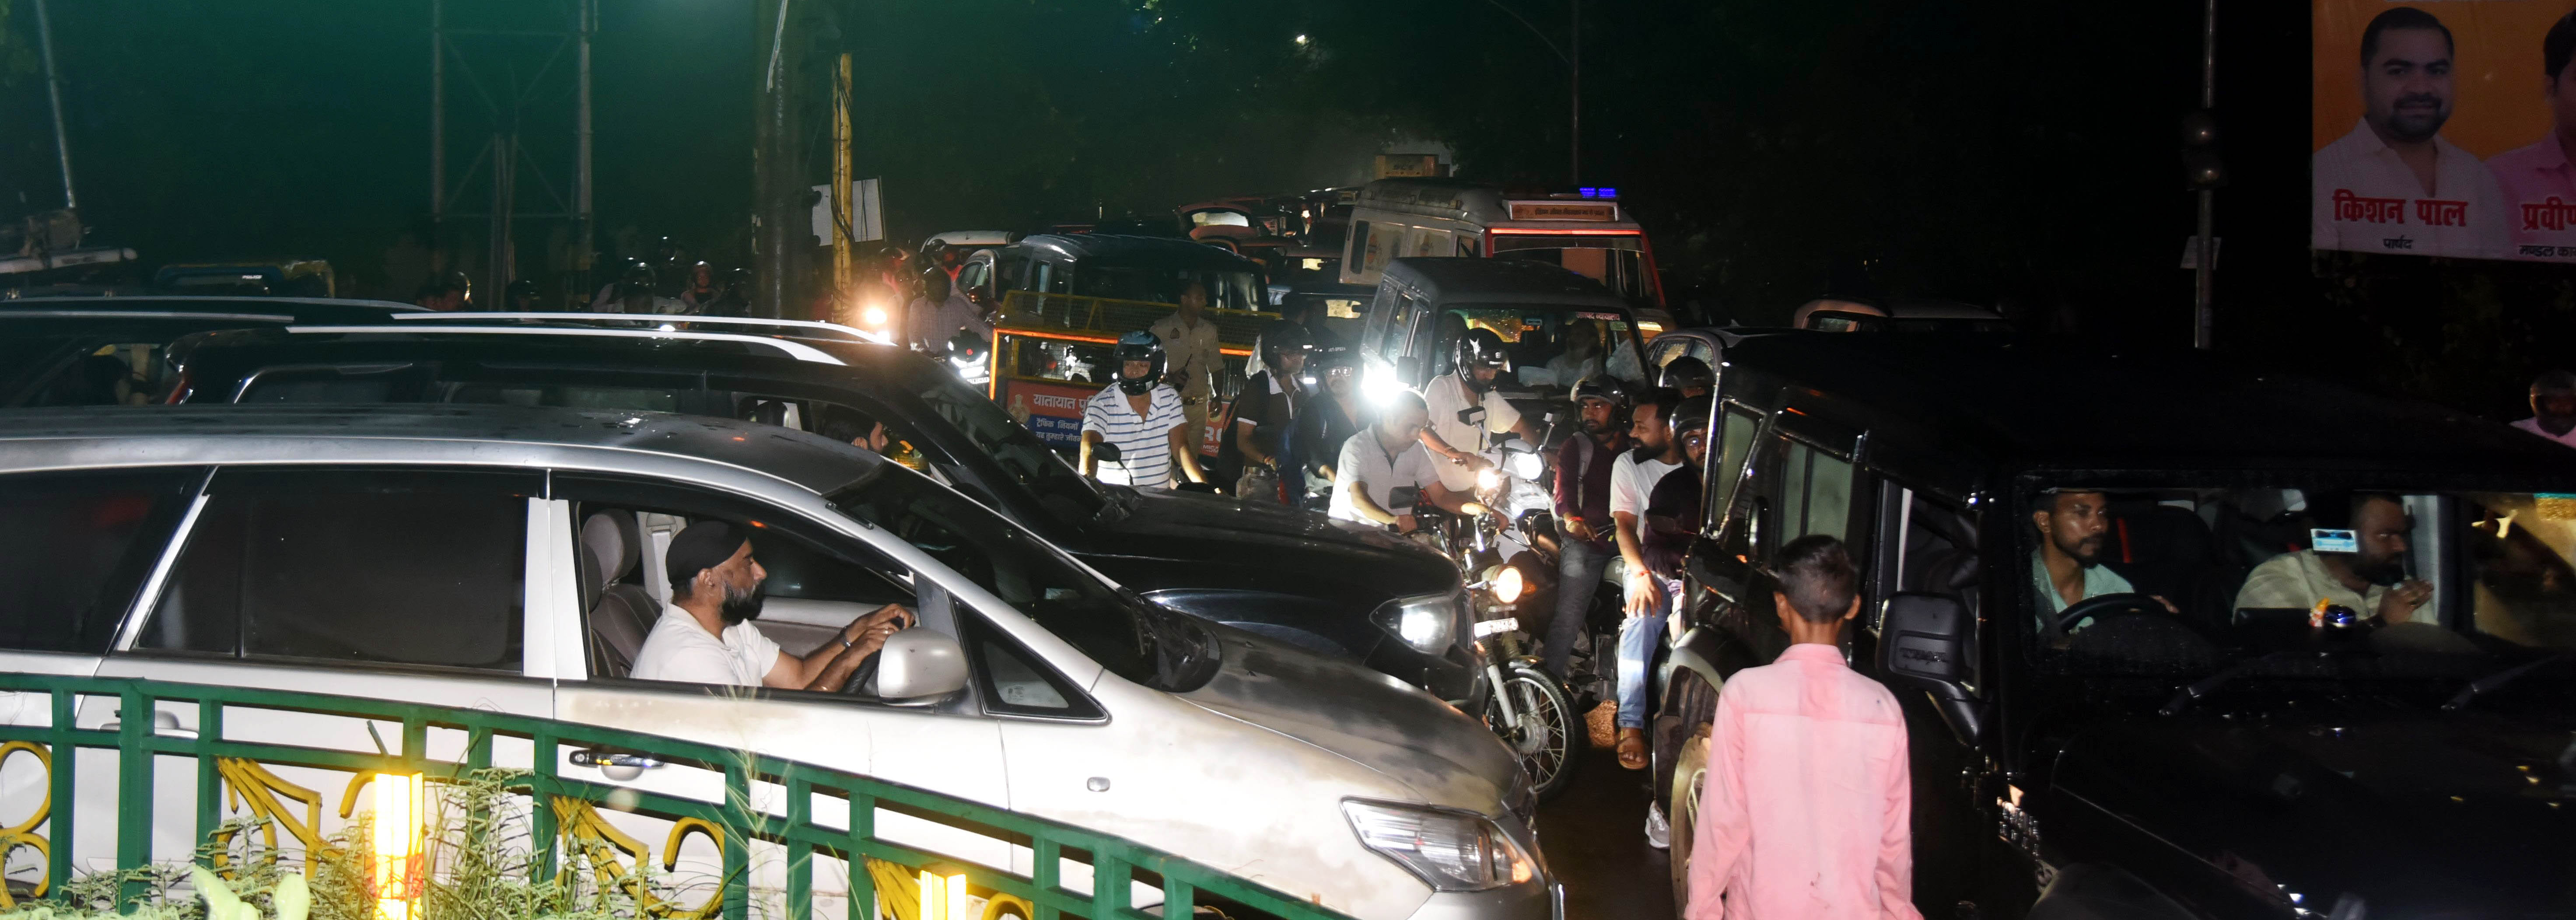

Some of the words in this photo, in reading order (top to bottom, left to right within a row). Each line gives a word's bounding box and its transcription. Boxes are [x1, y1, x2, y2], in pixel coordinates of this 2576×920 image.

[2332, 188, 2406, 224] किशन
[2415, 199, 2468, 227] पाल
[1033, 394, 1077, 410] यातायात
